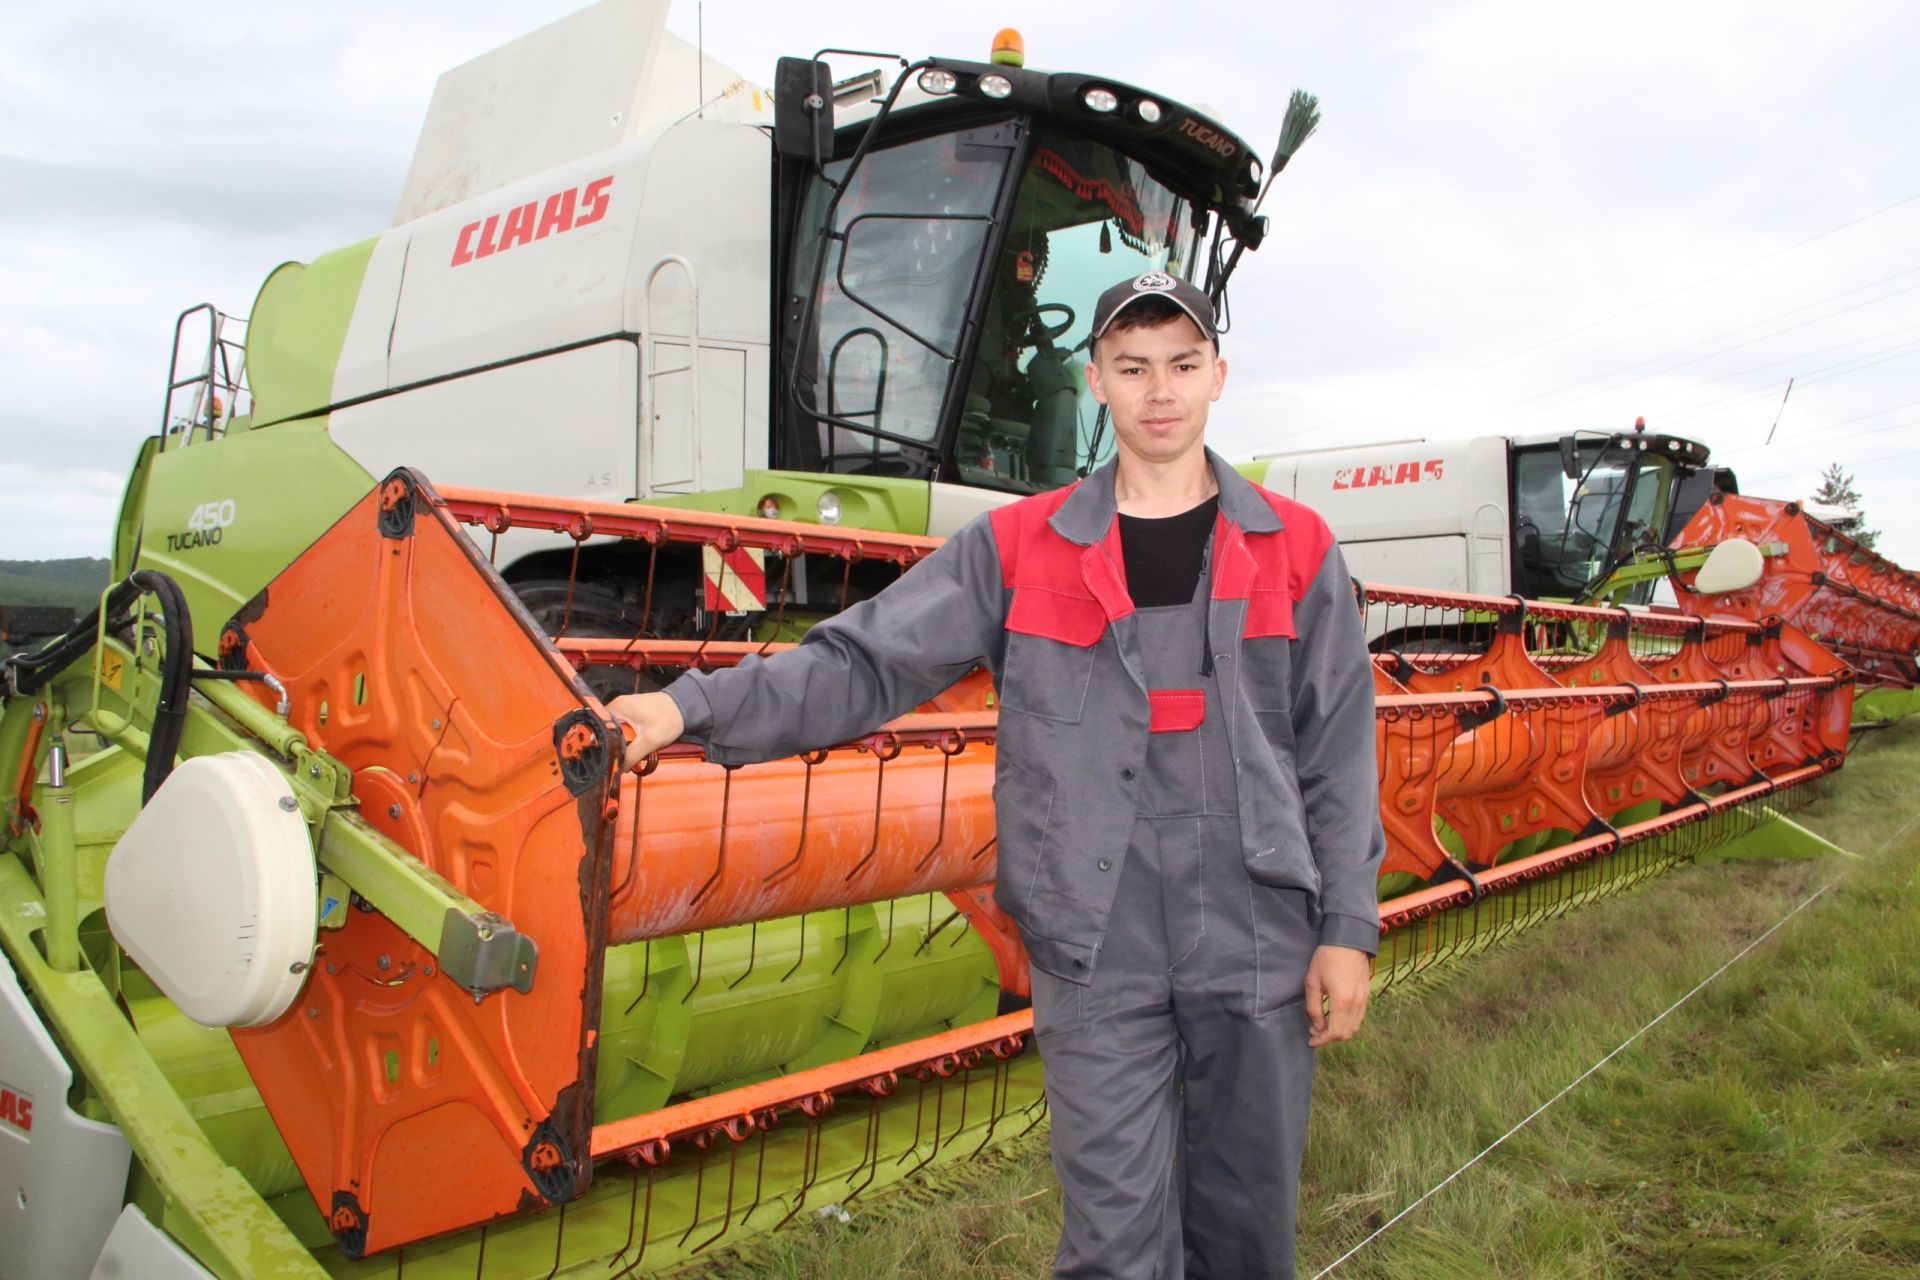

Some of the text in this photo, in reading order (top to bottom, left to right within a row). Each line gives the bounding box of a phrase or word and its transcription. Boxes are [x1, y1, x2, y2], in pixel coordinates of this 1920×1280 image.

[1179, 117, 1236, 157] TUCANO
[450, 174, 615, 267] CLAAS
[188, 498, 236, 529] 450
[167, 526, 223, 552] TUCANO
